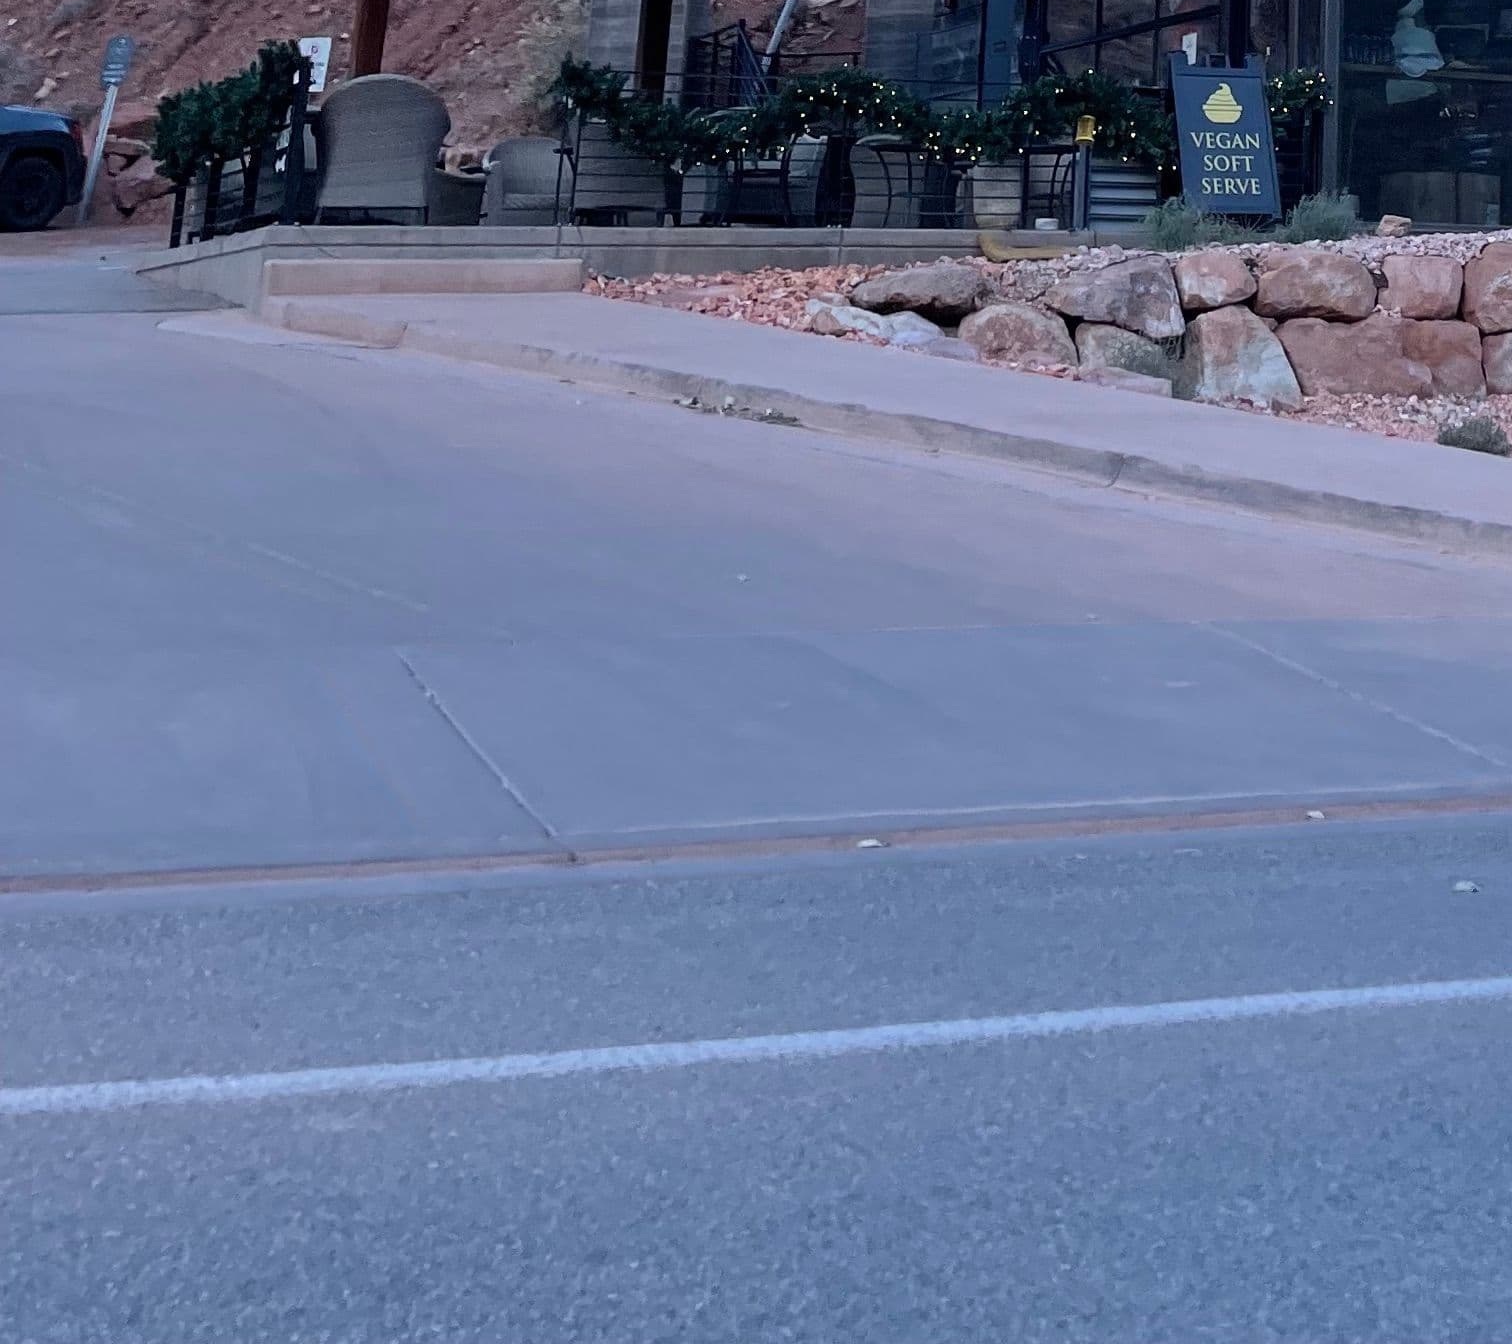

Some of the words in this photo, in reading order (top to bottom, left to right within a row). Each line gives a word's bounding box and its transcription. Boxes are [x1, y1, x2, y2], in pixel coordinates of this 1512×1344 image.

[1190, 132, 1260, 149] VEGAN
[1203, 154, 1254, 172] SOFT
[1201, 177, 1262, 194] SERVE
